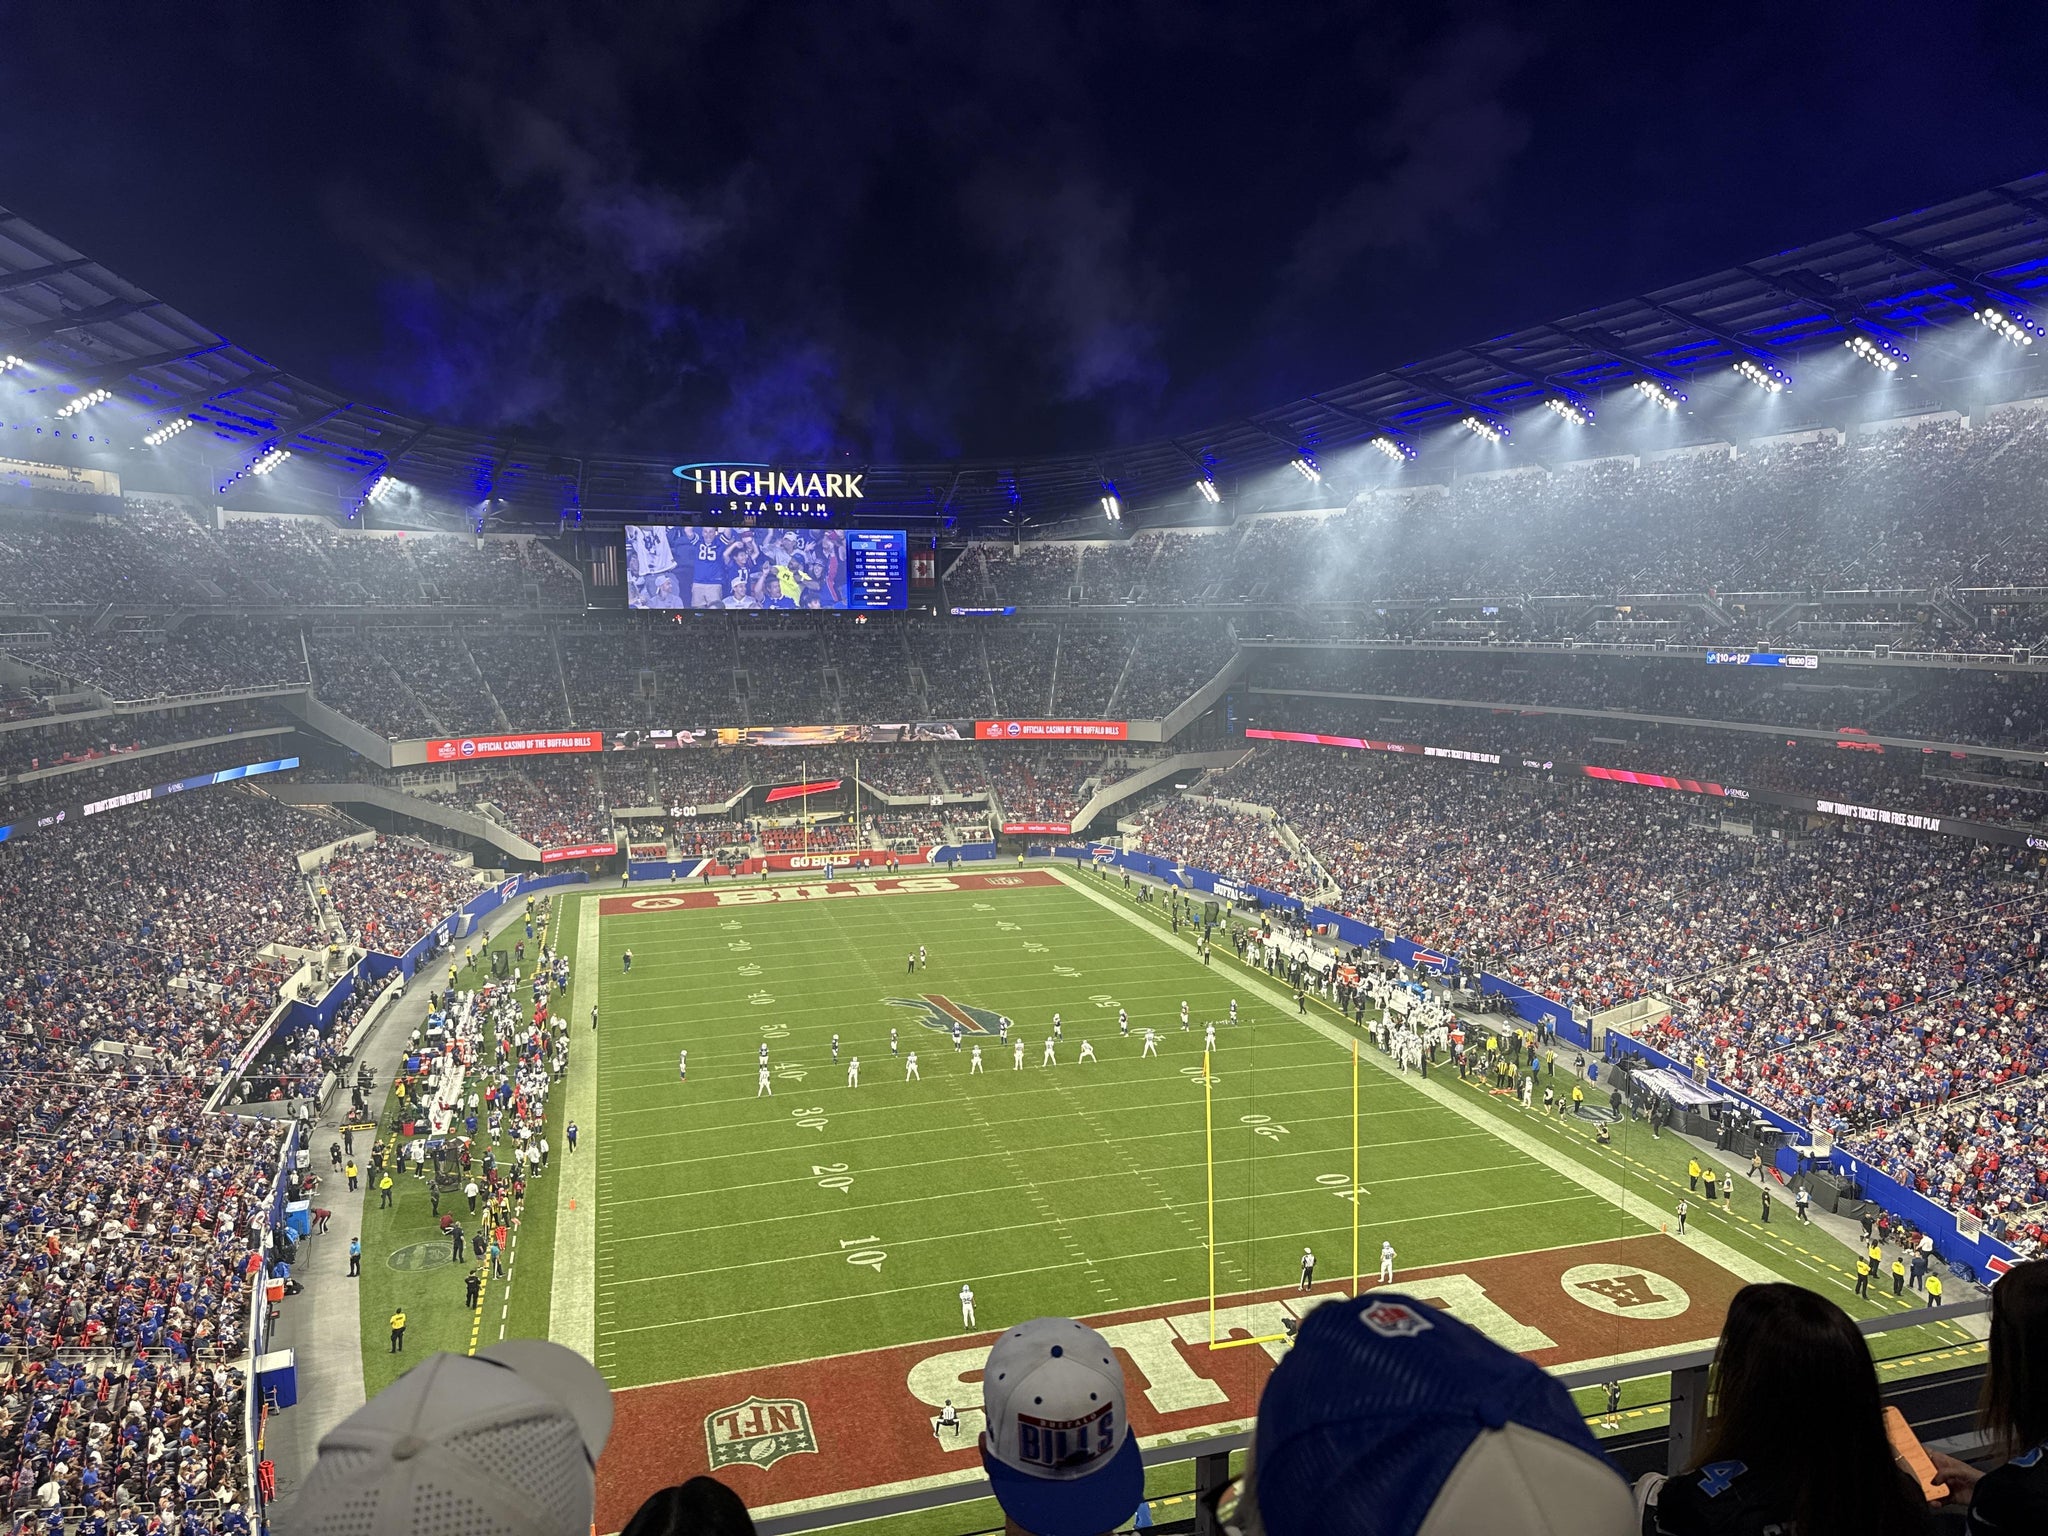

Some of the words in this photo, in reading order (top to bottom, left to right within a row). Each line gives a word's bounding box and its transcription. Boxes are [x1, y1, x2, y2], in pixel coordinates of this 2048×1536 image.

[695, 469, 864, 498] HIGHMARK
[730, 501, 826, 512] STADIUM
[699, 544, 716, 560] 85
[1740, 654, 1750, 663] 27
[1105, 726, 1119, 735] BILLS
[478, 742, 503, 752] OFFICIAL
[504, 741, 525, 750] CASINO
[526, 740, 534, 749] OF
[535, 739, 546, 748] THE
[547, 738, 574, 748] BUFFALO
[574, 738, 591, 746] BILLS
[1730, 789, 1750, 797] SENECA
[670, 806, 696, 817] 15:00
[1817, 800, 1834, 813] SHOW
[1834, 803, 1858, 817] TODAY'S
[1858, 807, 1879, 821] TICKET
[1879, 810, 1891, 823] FOR
[1892, 812, 1907, 826] FREE
[1907, 814, 1922, 828] SLOT
[1923, 817, 1940, 831] PLAY
[791, 857, 809, 867] GO
[714, 878, 960, 906] BILLS
[1088, 994, 1121, 1008] 50
[760, 1023, 790, 1038] 50
[774, 1063, 808, 1078] 40
[792, 1107, 828, 1127] 30
[1240, 1114, 1290, 1136] 20
[812, 1163, 854, 1188] 20
[1316, 1174, 1371, 1198] 10
[840, 1235, 887, 1264] 10
[716, 1406, 800, 1440] NFL
[1040, 1413, 1097, 1428] BUFFALO
[1018, 1412, 1114, 1464] BILLS
[1697, 1460, 1748, 1498] 4
